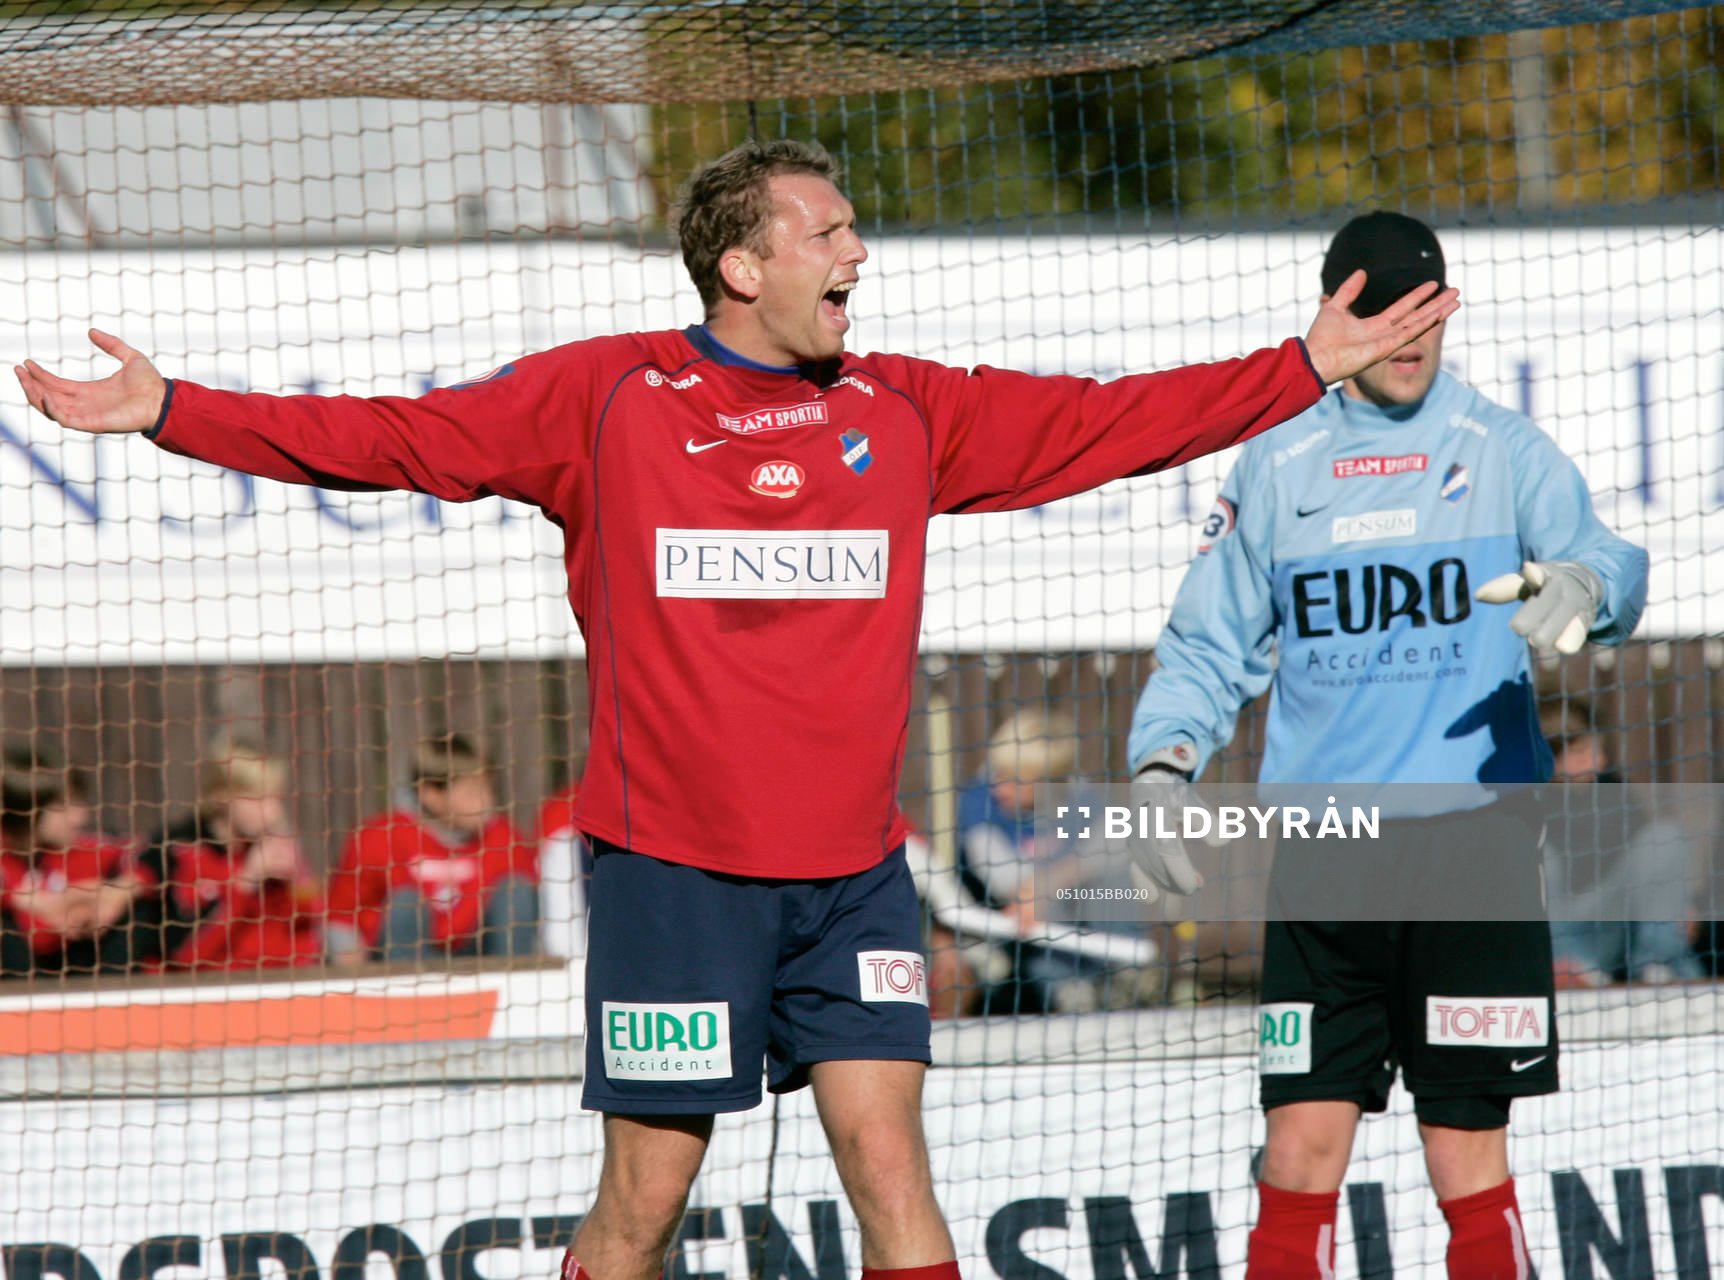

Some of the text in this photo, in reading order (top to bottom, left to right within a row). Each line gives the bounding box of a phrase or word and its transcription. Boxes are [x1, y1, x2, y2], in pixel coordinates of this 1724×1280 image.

[720, 405, 824, 432] TEAM SPORTIA
[756, 465, 800, 486] AXA
[1335, 459, 1381, 476] TEAM
[1336, 515, 1413, 537] PENSUM
[664, 544, 882, 583] PENSUM
[1293, 557, 1472, 639] EURO
[1306, 642, 1463, 670] Accident
[608, 1010, 718, 1052] EURO
[1435, 1005, 1541, 1039] TOFTA
[615, 1056, 713, 1071] Accident
